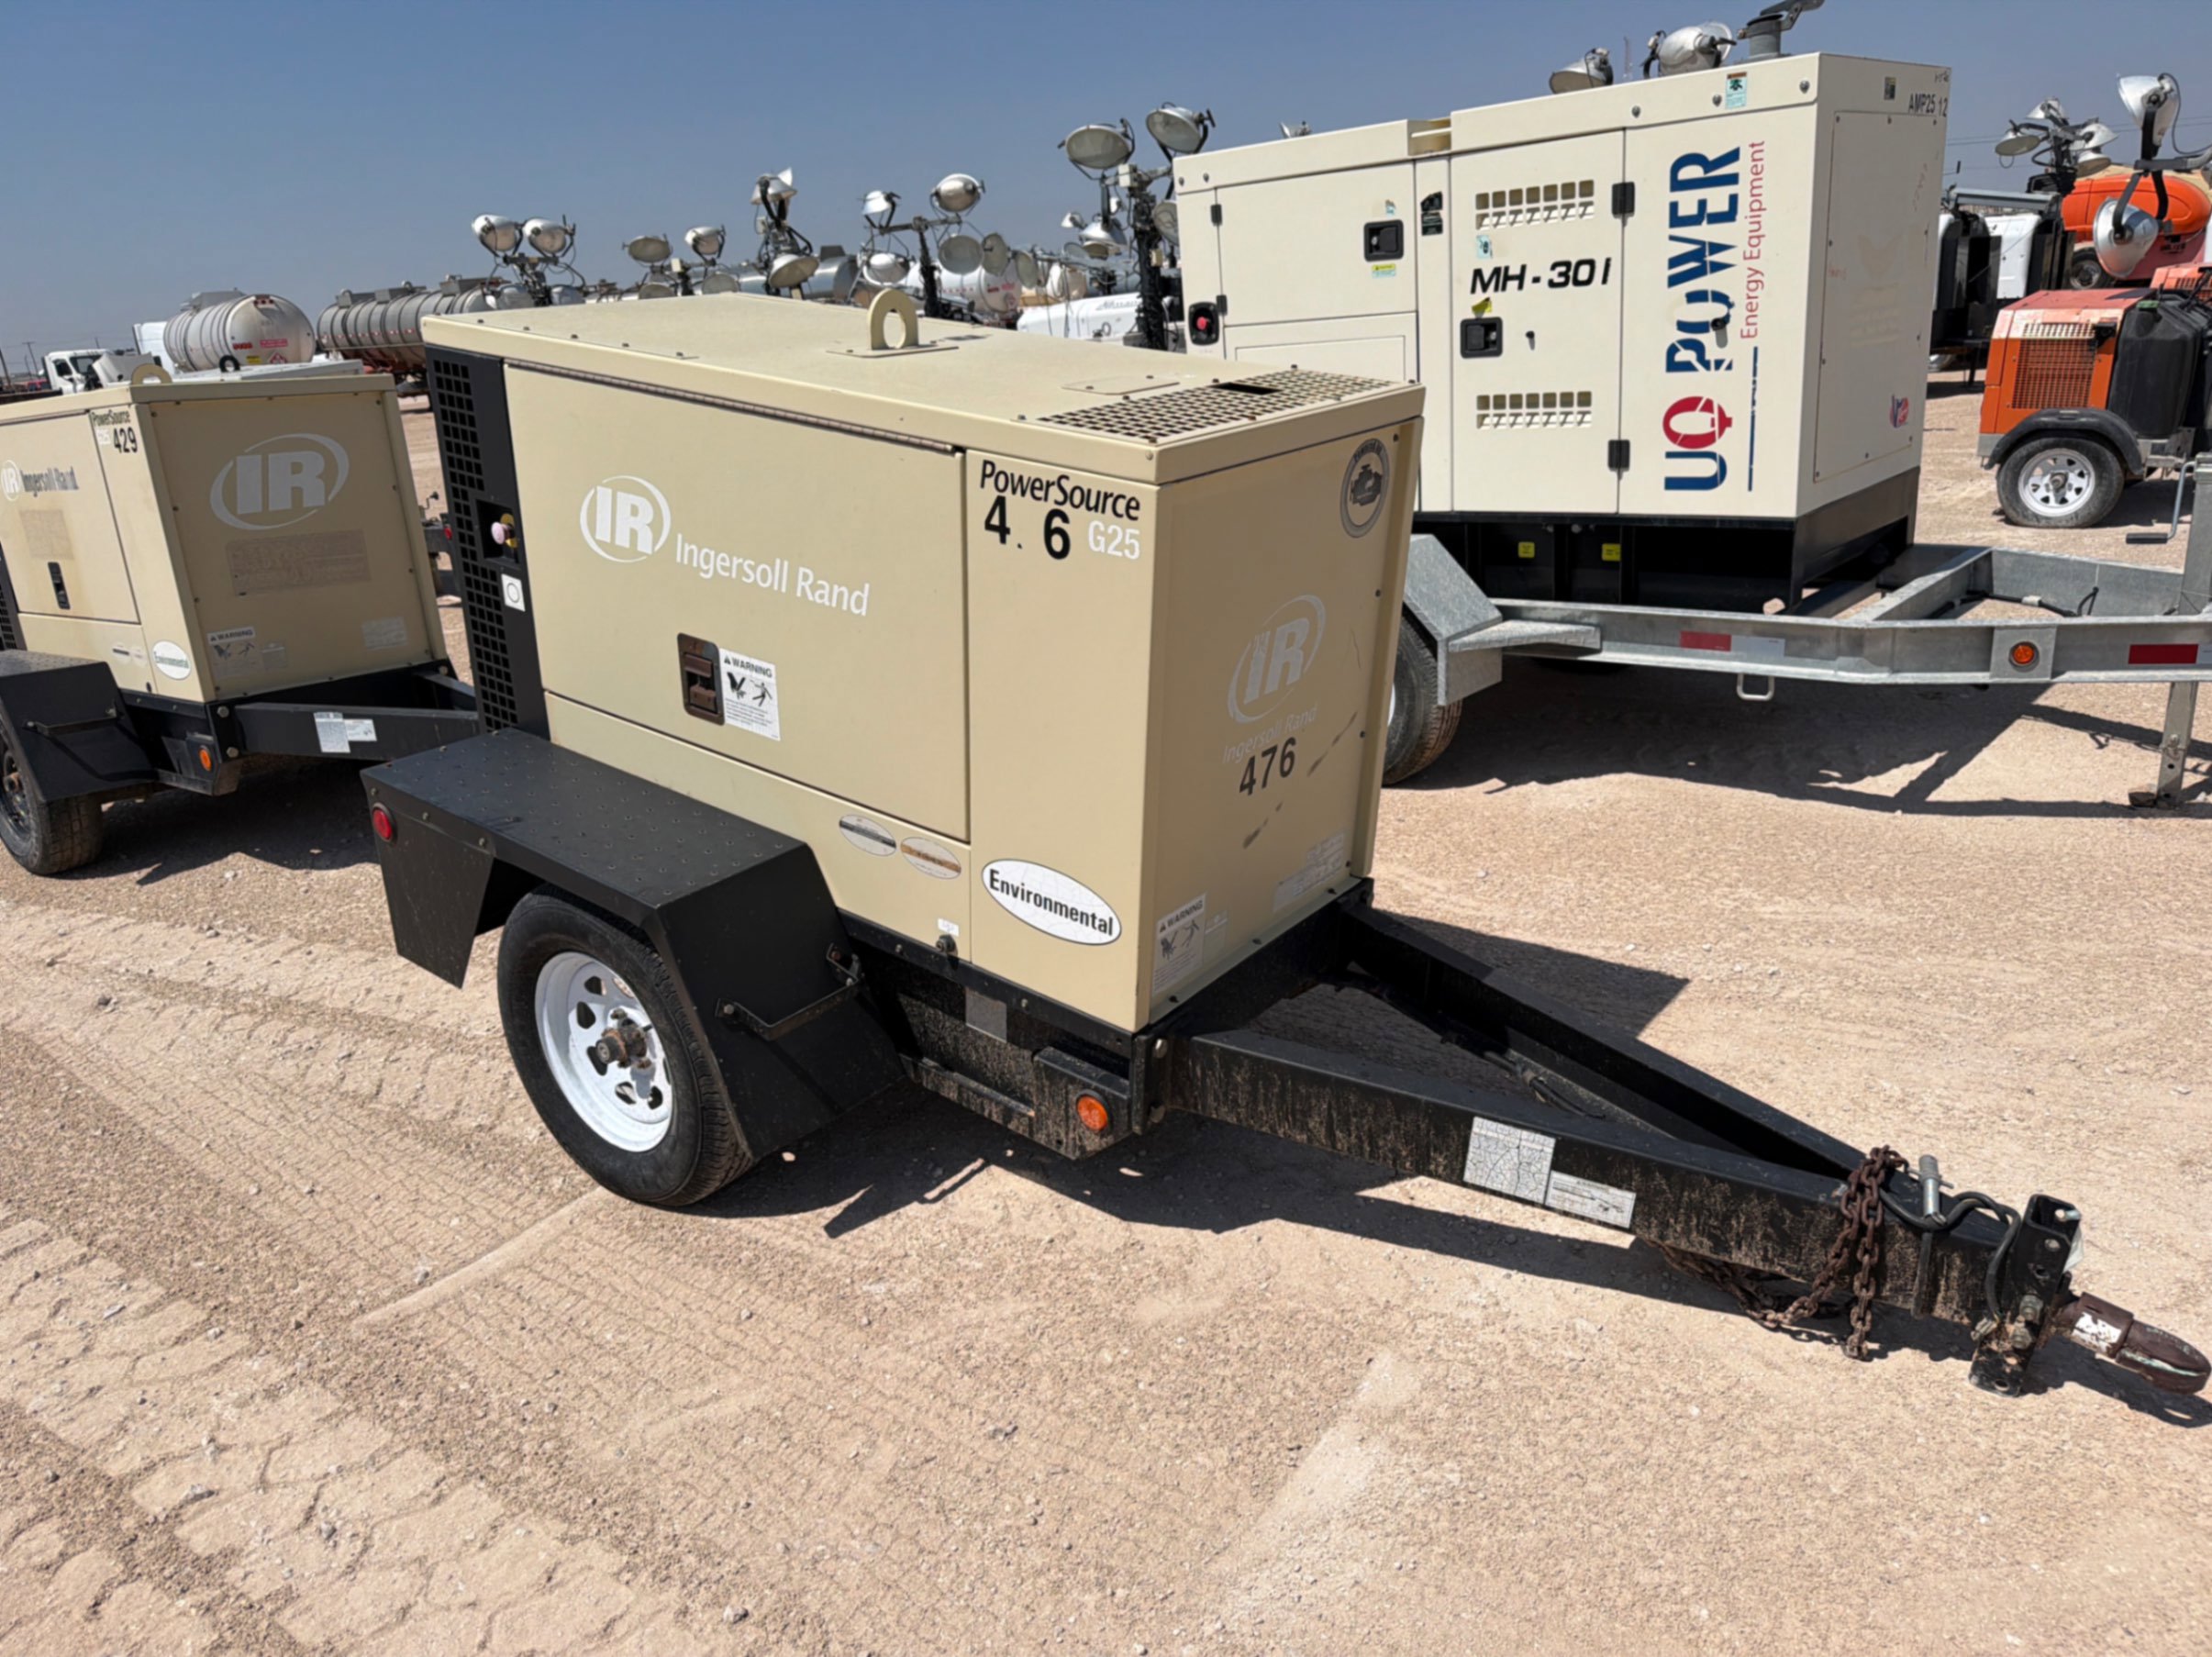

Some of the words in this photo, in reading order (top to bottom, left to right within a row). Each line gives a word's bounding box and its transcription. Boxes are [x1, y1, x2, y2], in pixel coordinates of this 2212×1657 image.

[1742, 140, 1767, 261] Equipment
[1664, 146, 1741, 373] POWER
[1740, 266, 1765, 339] Energy
[114, 427, 138, 453] 429
[1662, 395, 1733, 491] UQ
[236, 450, 326, 515] IR
[980, 459, 1141, 521] PowerSource
[595, 484, 654, 555] IR
[675, 533, 789, 594] Ingersoll
[795, 566, 871, 617] Rand
[1088, 520, 1140, 560] G25
[731, 657, 773, 678] WARNING
[1242, 617, 1310, 705] IR
[1222, 719, 1283, 764] Ingersoll
[1284, 701, 1319, 732] Rand
[1239, 737, 1296, 795] 476
[989, 869, 1114, 936] Environmental
[1167, 899, 1204, 928] WARNING
